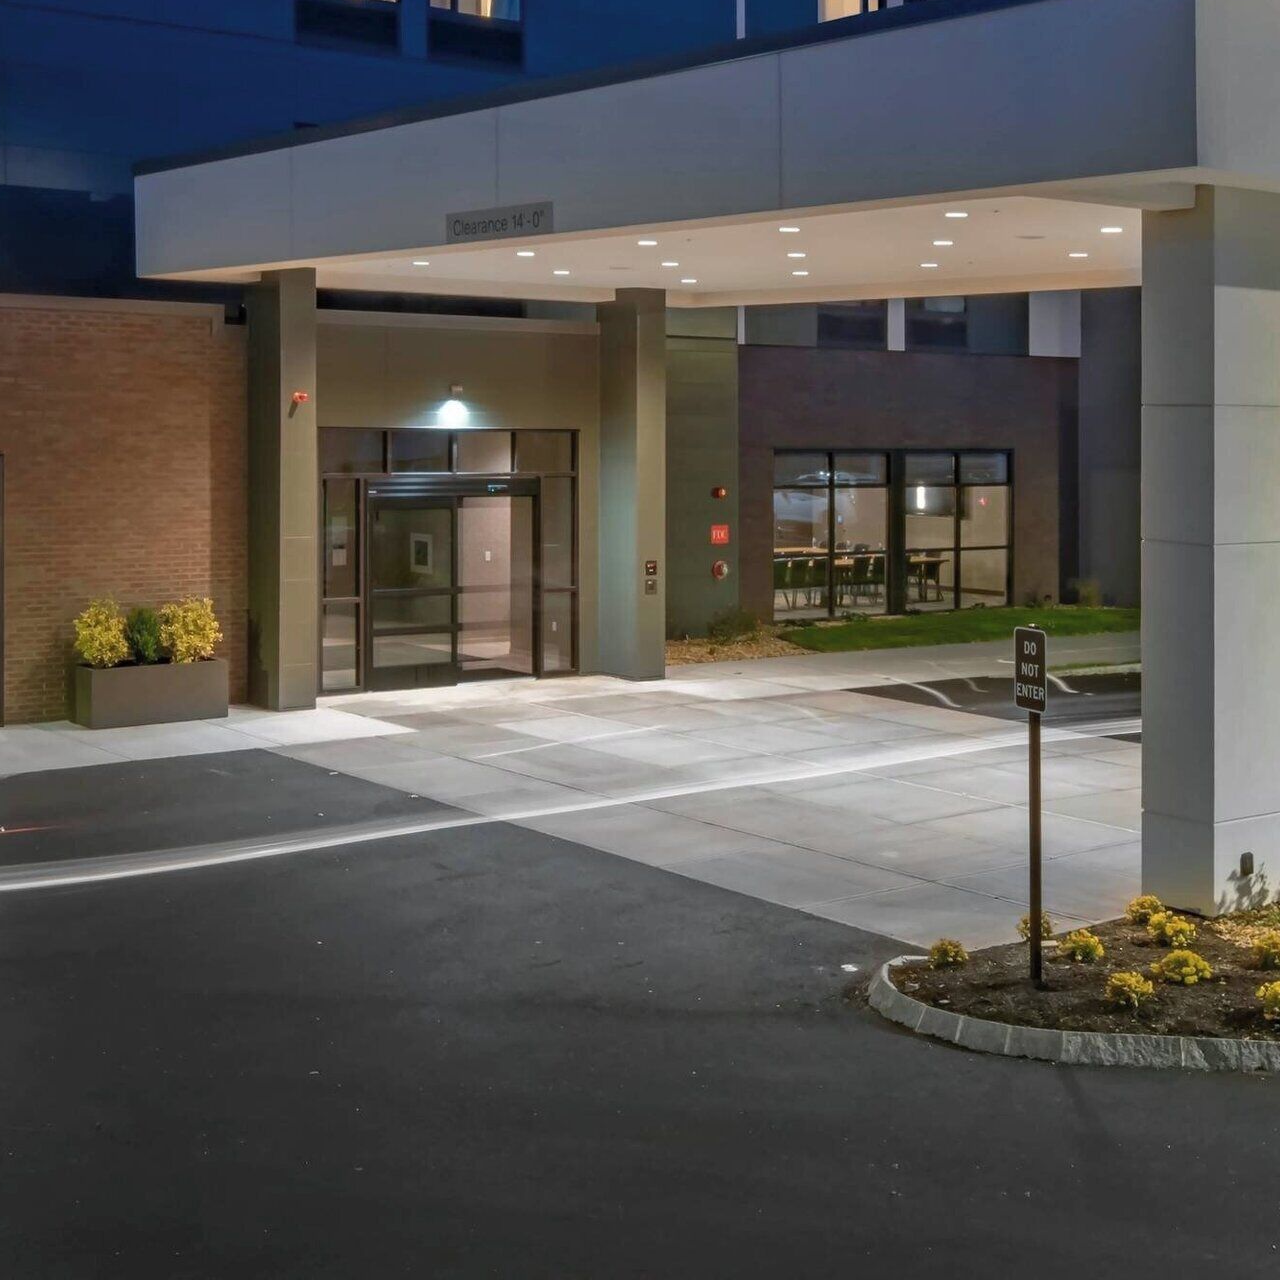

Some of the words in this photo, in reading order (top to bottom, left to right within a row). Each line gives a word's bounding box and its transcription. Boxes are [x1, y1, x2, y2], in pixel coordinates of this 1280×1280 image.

[453, 216, 508, 236] Clearance
[1023, 640, 1037, 656] DO
[1021, 662, 1040, 678] NOT
[1016, 682, 1045, 701] ENTER
